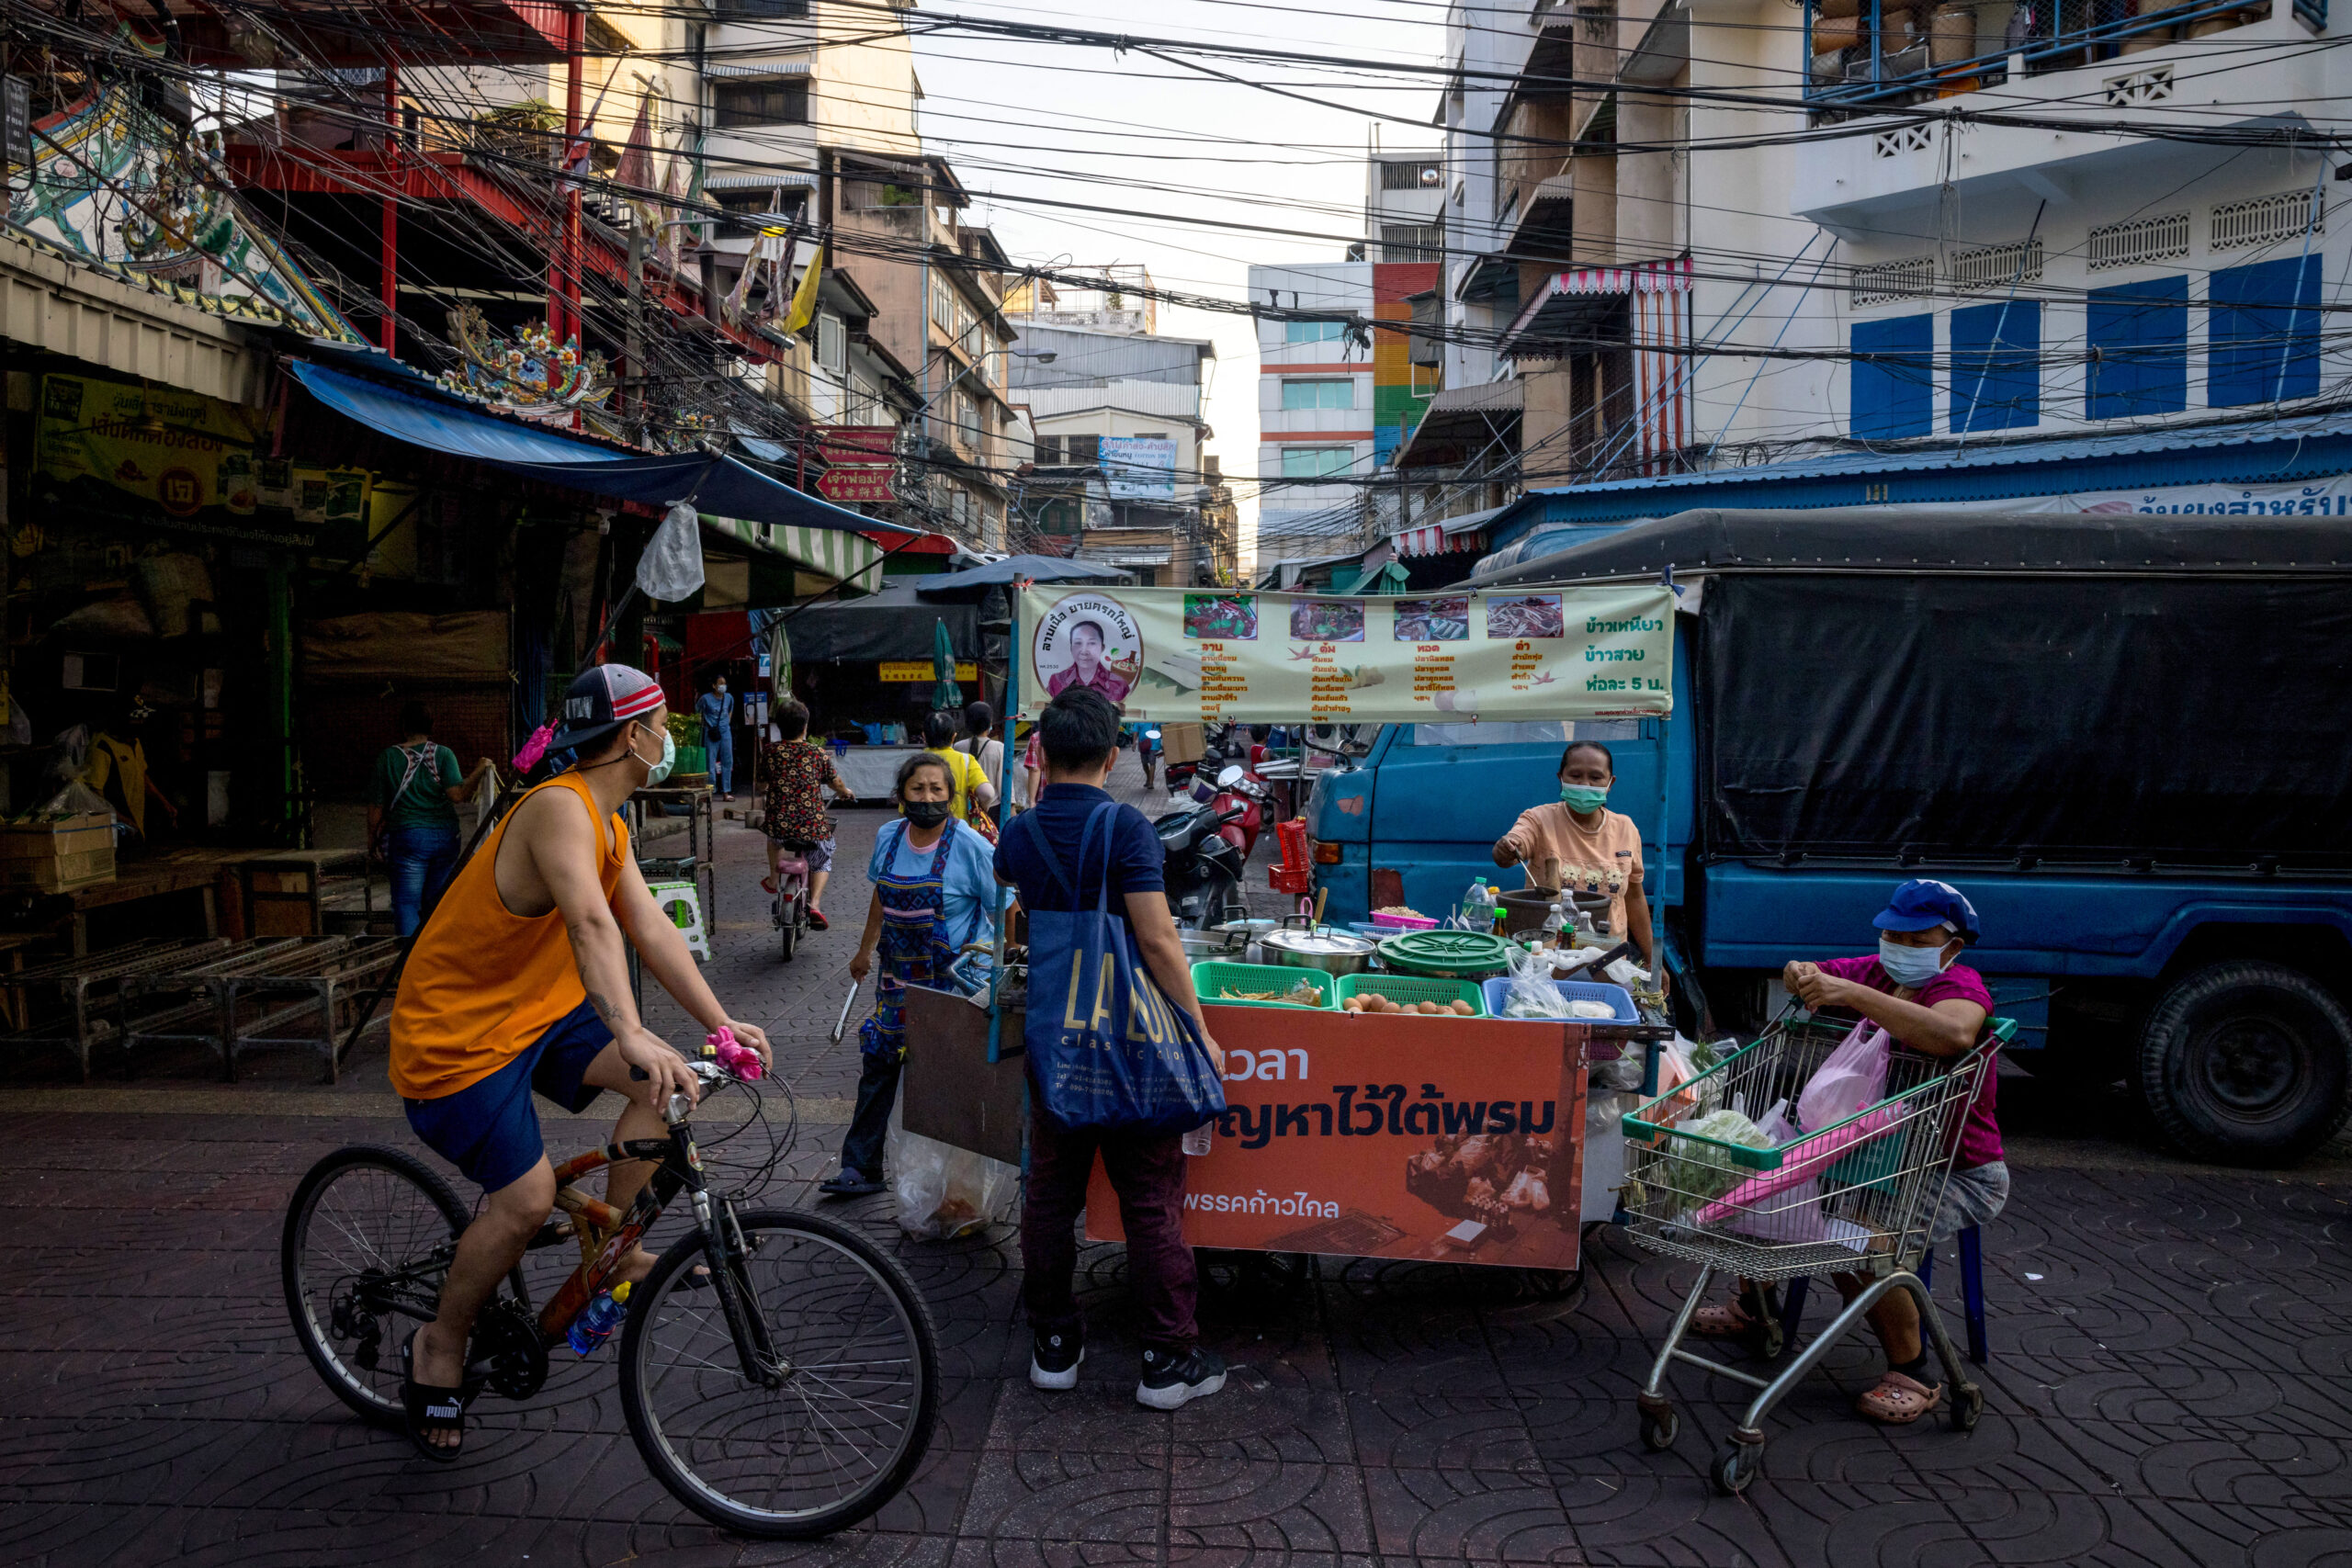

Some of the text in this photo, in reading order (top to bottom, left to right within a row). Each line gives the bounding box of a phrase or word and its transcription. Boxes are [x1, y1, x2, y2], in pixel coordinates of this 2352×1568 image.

[828, 471, 884, 484] เจ้าพ่อม้า
[1042, 602, 1136, 651] ลาบเนื้อ ยายครกใหญ่
[1586, 616, 1664, 634] ข้าวเหนียว
[1202, 643, 1223, 651] ลาบ
[1319, 642, 1336, 653] ต้ม
[1417, 644, 1441, 652] ทอด
[1515, 639, 1531, 650] ตำ
[1585, 645, 1645, 662] ข้าวสวย
[1586, 674, 1664, 691] ห่อละ 5 บ.
[1063, 949, 1114, 1035] LA
[1061, 1033, 1144, 1059] clasic
[1221, 1048, 1308, 1081] เวลา
[1212, 1083, 1555, 1149] ญหาไว้ใต้พรม
[1183, 1190, 1340, 1219] พรรคก้าวไกล
[426, 1405, 458, 1418] PUMA
